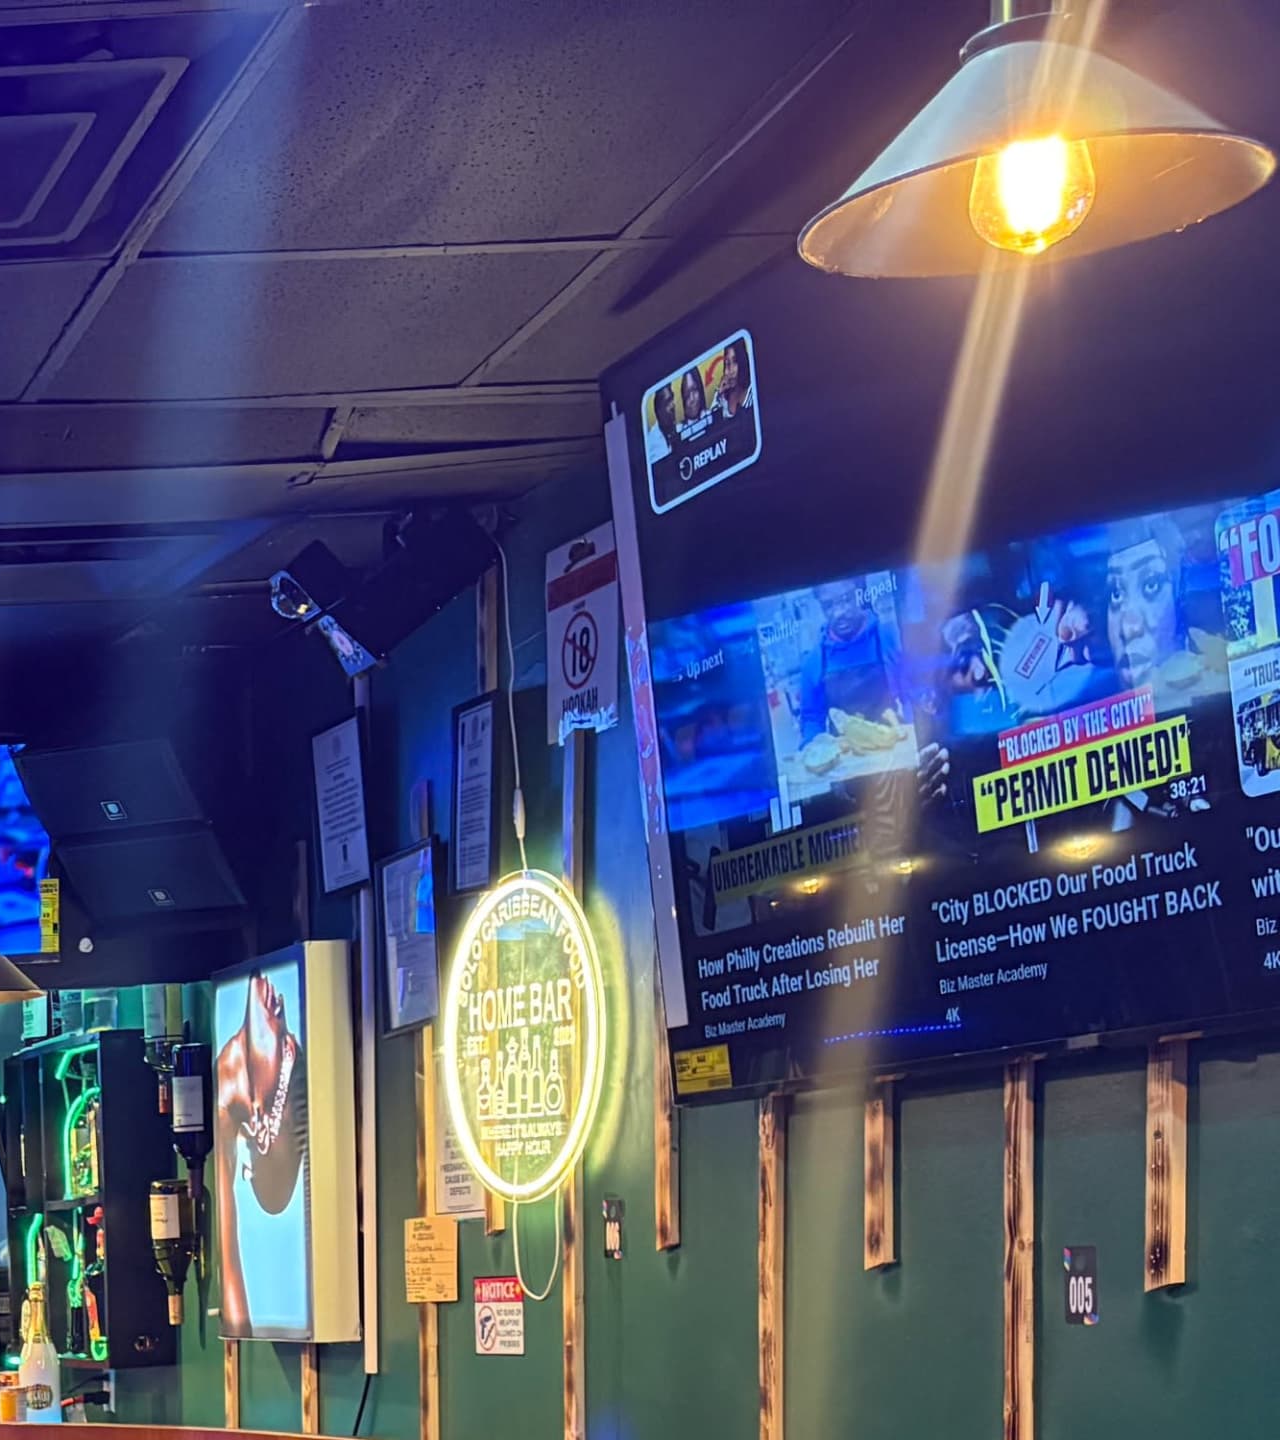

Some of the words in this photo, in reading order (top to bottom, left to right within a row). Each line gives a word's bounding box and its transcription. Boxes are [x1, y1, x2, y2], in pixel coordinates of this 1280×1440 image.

[693, 439, 727, 470] REPLAY
[855, 574, 898, 607] Repeat
[686, 659, 699, 680] Up
[701, 648, 725, 673] next
[1063, 719, 1080, 743] BY
[1083, 711, 1108, 739] THE
[1169, 775, 1207, 800] 38:21
[712, 836, 805, 892] UNBREAKABLE
[808, 822, 861, 865] MOTHE
[973, 879, 1053, 917] BLOCKED
[1056, 872, 1088, 897] Our
[1092, 854, 1138, 890] Food
[1141, 841, 1198, 878] Truck
[1049, 913, 1079, 940] We
[1082, 893, 1161, 933] FOUGHT
[1165, 880, 1223, 917] BACK
[1256, 917, 1278, 936] Biz
[481, 894, 559, 942] CARIBBEAN
[555, 918, 587, 990] FOOD
[697, 956, 725, 979] How
[726, 946, 761, 974] Philly
[762, 934, 825, 964] Creations
[827, 918, 876, 950] Rebuilt
[879, 914, 906, 938] Her
[700, 986, 732, 1012] Food
[733, 977, 770, 1005] Truck
[771, 971, 804, 997] After
[806, 962, 851, 991] Losing
[854, 958, 880, 979] Her
[939, 978, 956, 995] Biz
[958, 971, 994, 993] Master
[997, 962, 1049, 985] Academy
[469, 984, 527, 1033] HOME
[529, 977, 574, 1026] BAR
[945, 1007, 961, 1023] 4K
[704, 1023, 718, 1039] Biz
[718, 1019, 746, 1037] Master
[747, 1011, 787, 1031] Academy
[481, 1281, 516, 1301] NOTICE
[1069, 1275, 1093, 1314] 005
